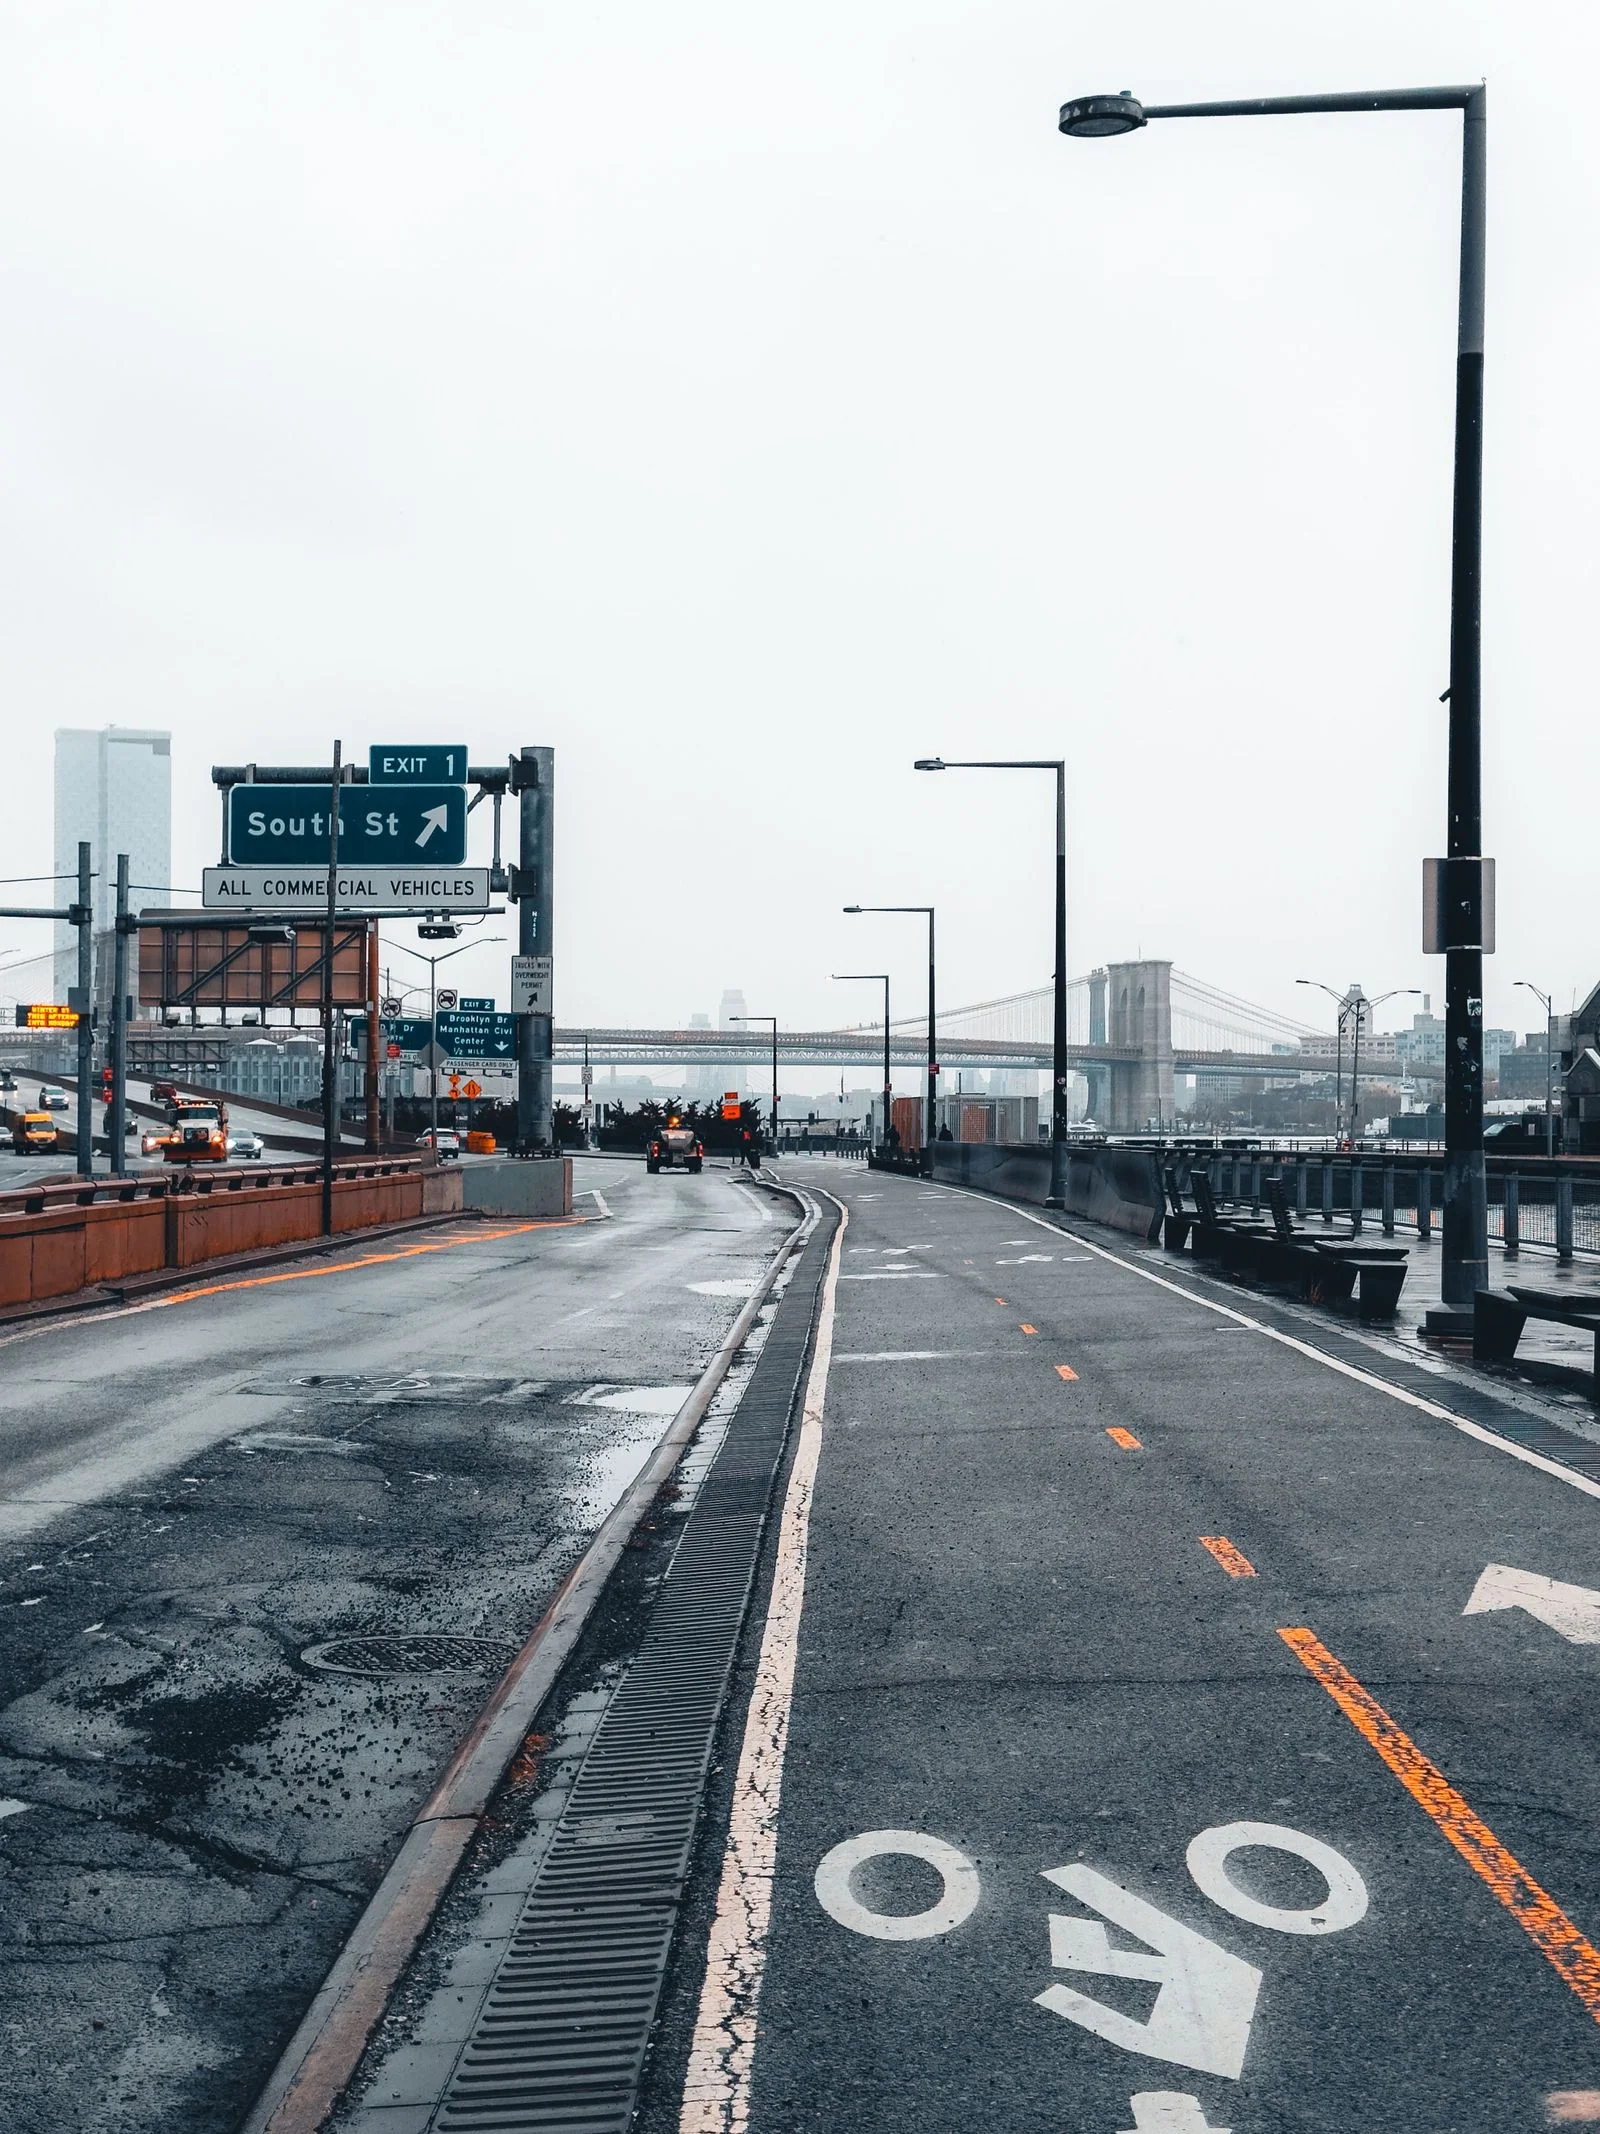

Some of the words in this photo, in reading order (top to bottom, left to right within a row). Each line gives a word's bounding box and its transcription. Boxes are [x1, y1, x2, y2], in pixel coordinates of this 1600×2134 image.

[383, 757, 427, 773] EXIT
[446, 754, 454, 776] 1
[248, 811, 344, 836] South
[365, 811, 399, 836] St
[218, 880, 251, 896] ALL
[263, 880, 378, 896] COMMECIAL
[390, 880, 474, 896] VEHICLES
[515, 971, 549, 979] OVERWEIGHT
[520, 981, 543, 989] PERMIT
[484, 1001, 491, 1009] 2
[449, 1014, 490, 1025] Brooklyn
[497, 1016, 508, 1024] Br
[403, 1024, 414, 1032] Dr
[440, 1025, 489, 1034] Manhattan
[494, 1027, 512, 1035] Civi
[454, 1036, 485, 1045] Center
